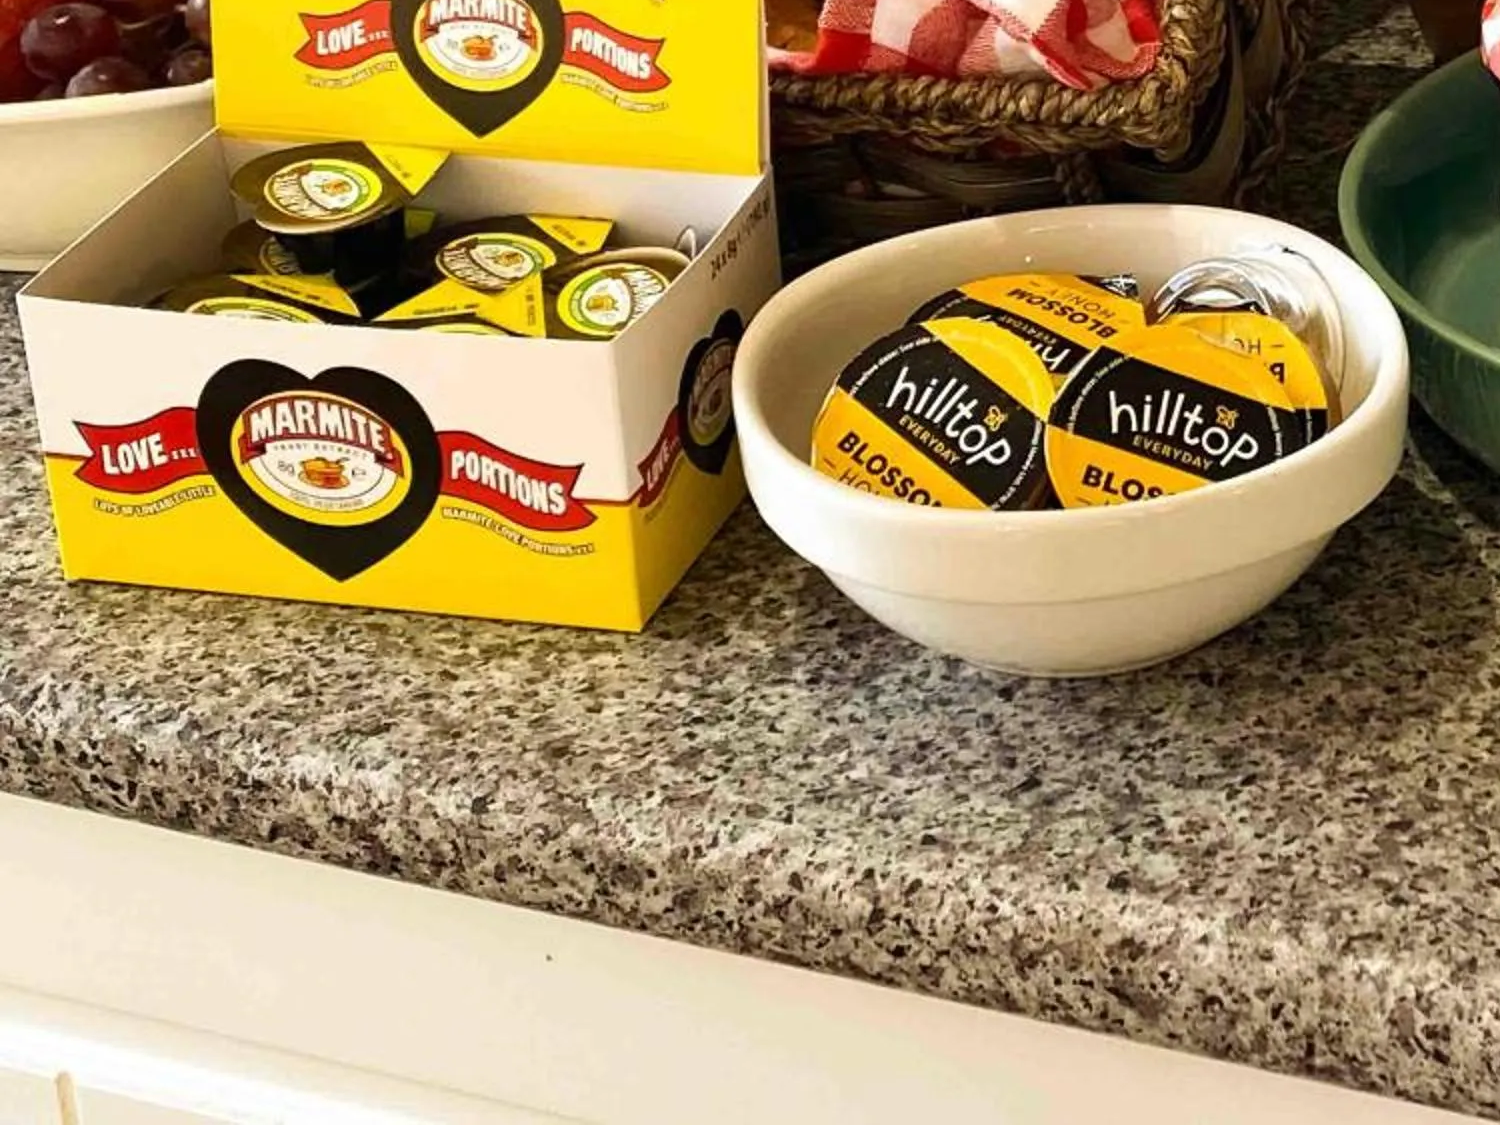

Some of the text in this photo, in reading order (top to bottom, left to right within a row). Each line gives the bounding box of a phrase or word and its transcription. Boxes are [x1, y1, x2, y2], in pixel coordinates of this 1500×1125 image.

[570, 25, 654, 81] PORTIONS
[1006, 286, 1119, 339] BLOSSOM
[250, 399, 386, 455] MARMITE
[885, 365, 1012, 467] hilltop
[898, 414, 963, 466] EVERYDAY
[1108, 388, 1259, 468] hilltop
[836, 430, 943, 508] BLOSSO
[1131, 433, 1215, 473] EVERYDAY
[450, 449, 568, 517] PORTIONS
